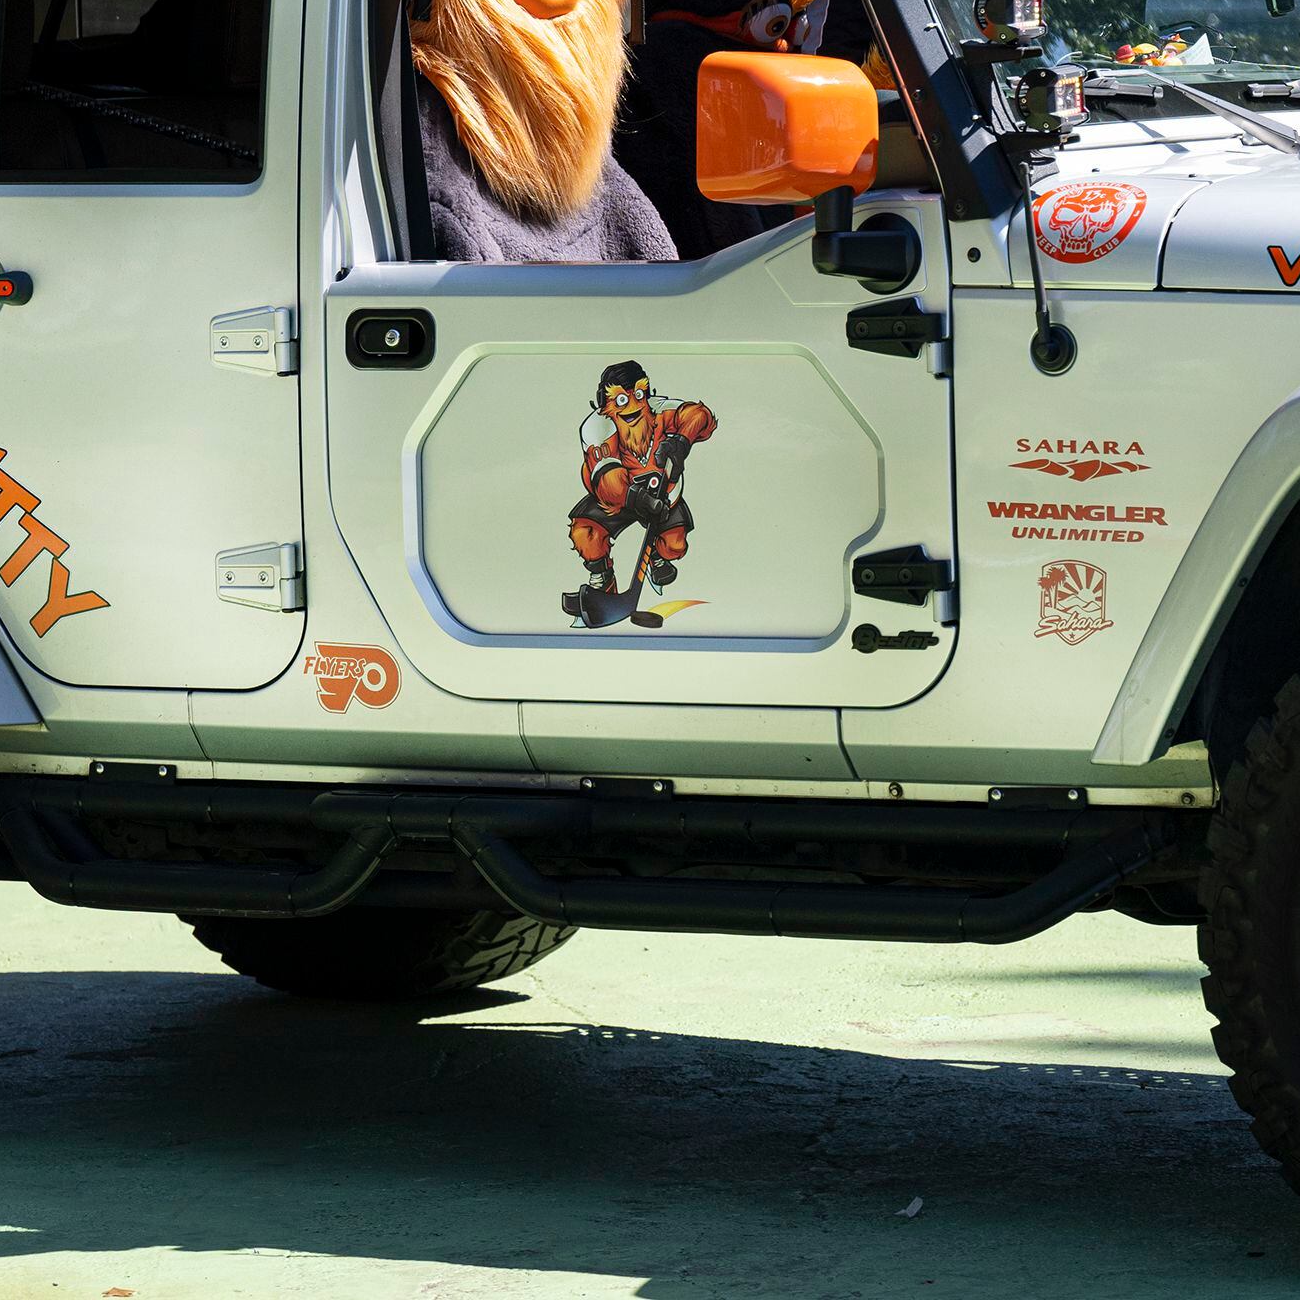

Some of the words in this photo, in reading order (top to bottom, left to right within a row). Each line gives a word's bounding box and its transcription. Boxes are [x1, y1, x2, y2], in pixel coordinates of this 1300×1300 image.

[1037, 234, 1058, 255] JEEP
[1092, 238, 1121, 258] CLUB
[1016, 438, 1146, 456] SAHARA
[986, 501, 1169, 526] WRANGLER
[1011, 526, 1145, 543] UNLIMITED
[1033, 610, 1115, 638] Sahara
[303, 656, 367, 678] FLYERS
